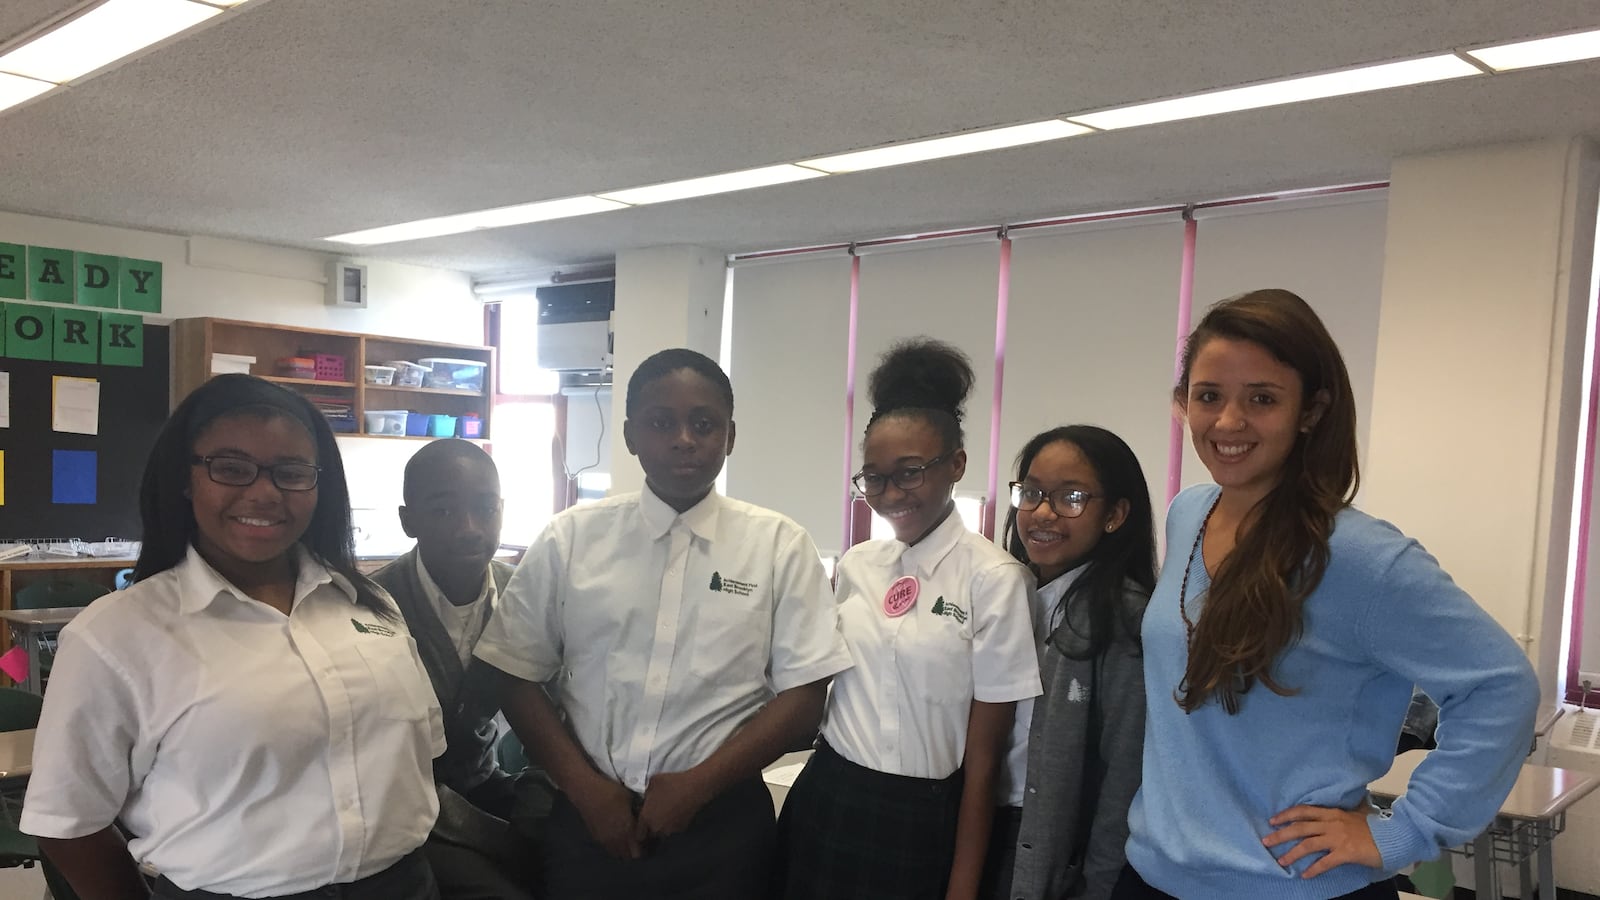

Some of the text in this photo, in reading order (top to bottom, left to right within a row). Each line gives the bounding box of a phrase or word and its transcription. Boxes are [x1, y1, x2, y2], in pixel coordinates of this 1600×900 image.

[0, 254, 154, 294] EADY
[14, 315, 136, 349] ORK
[888, 585, 912, 604] CURE
